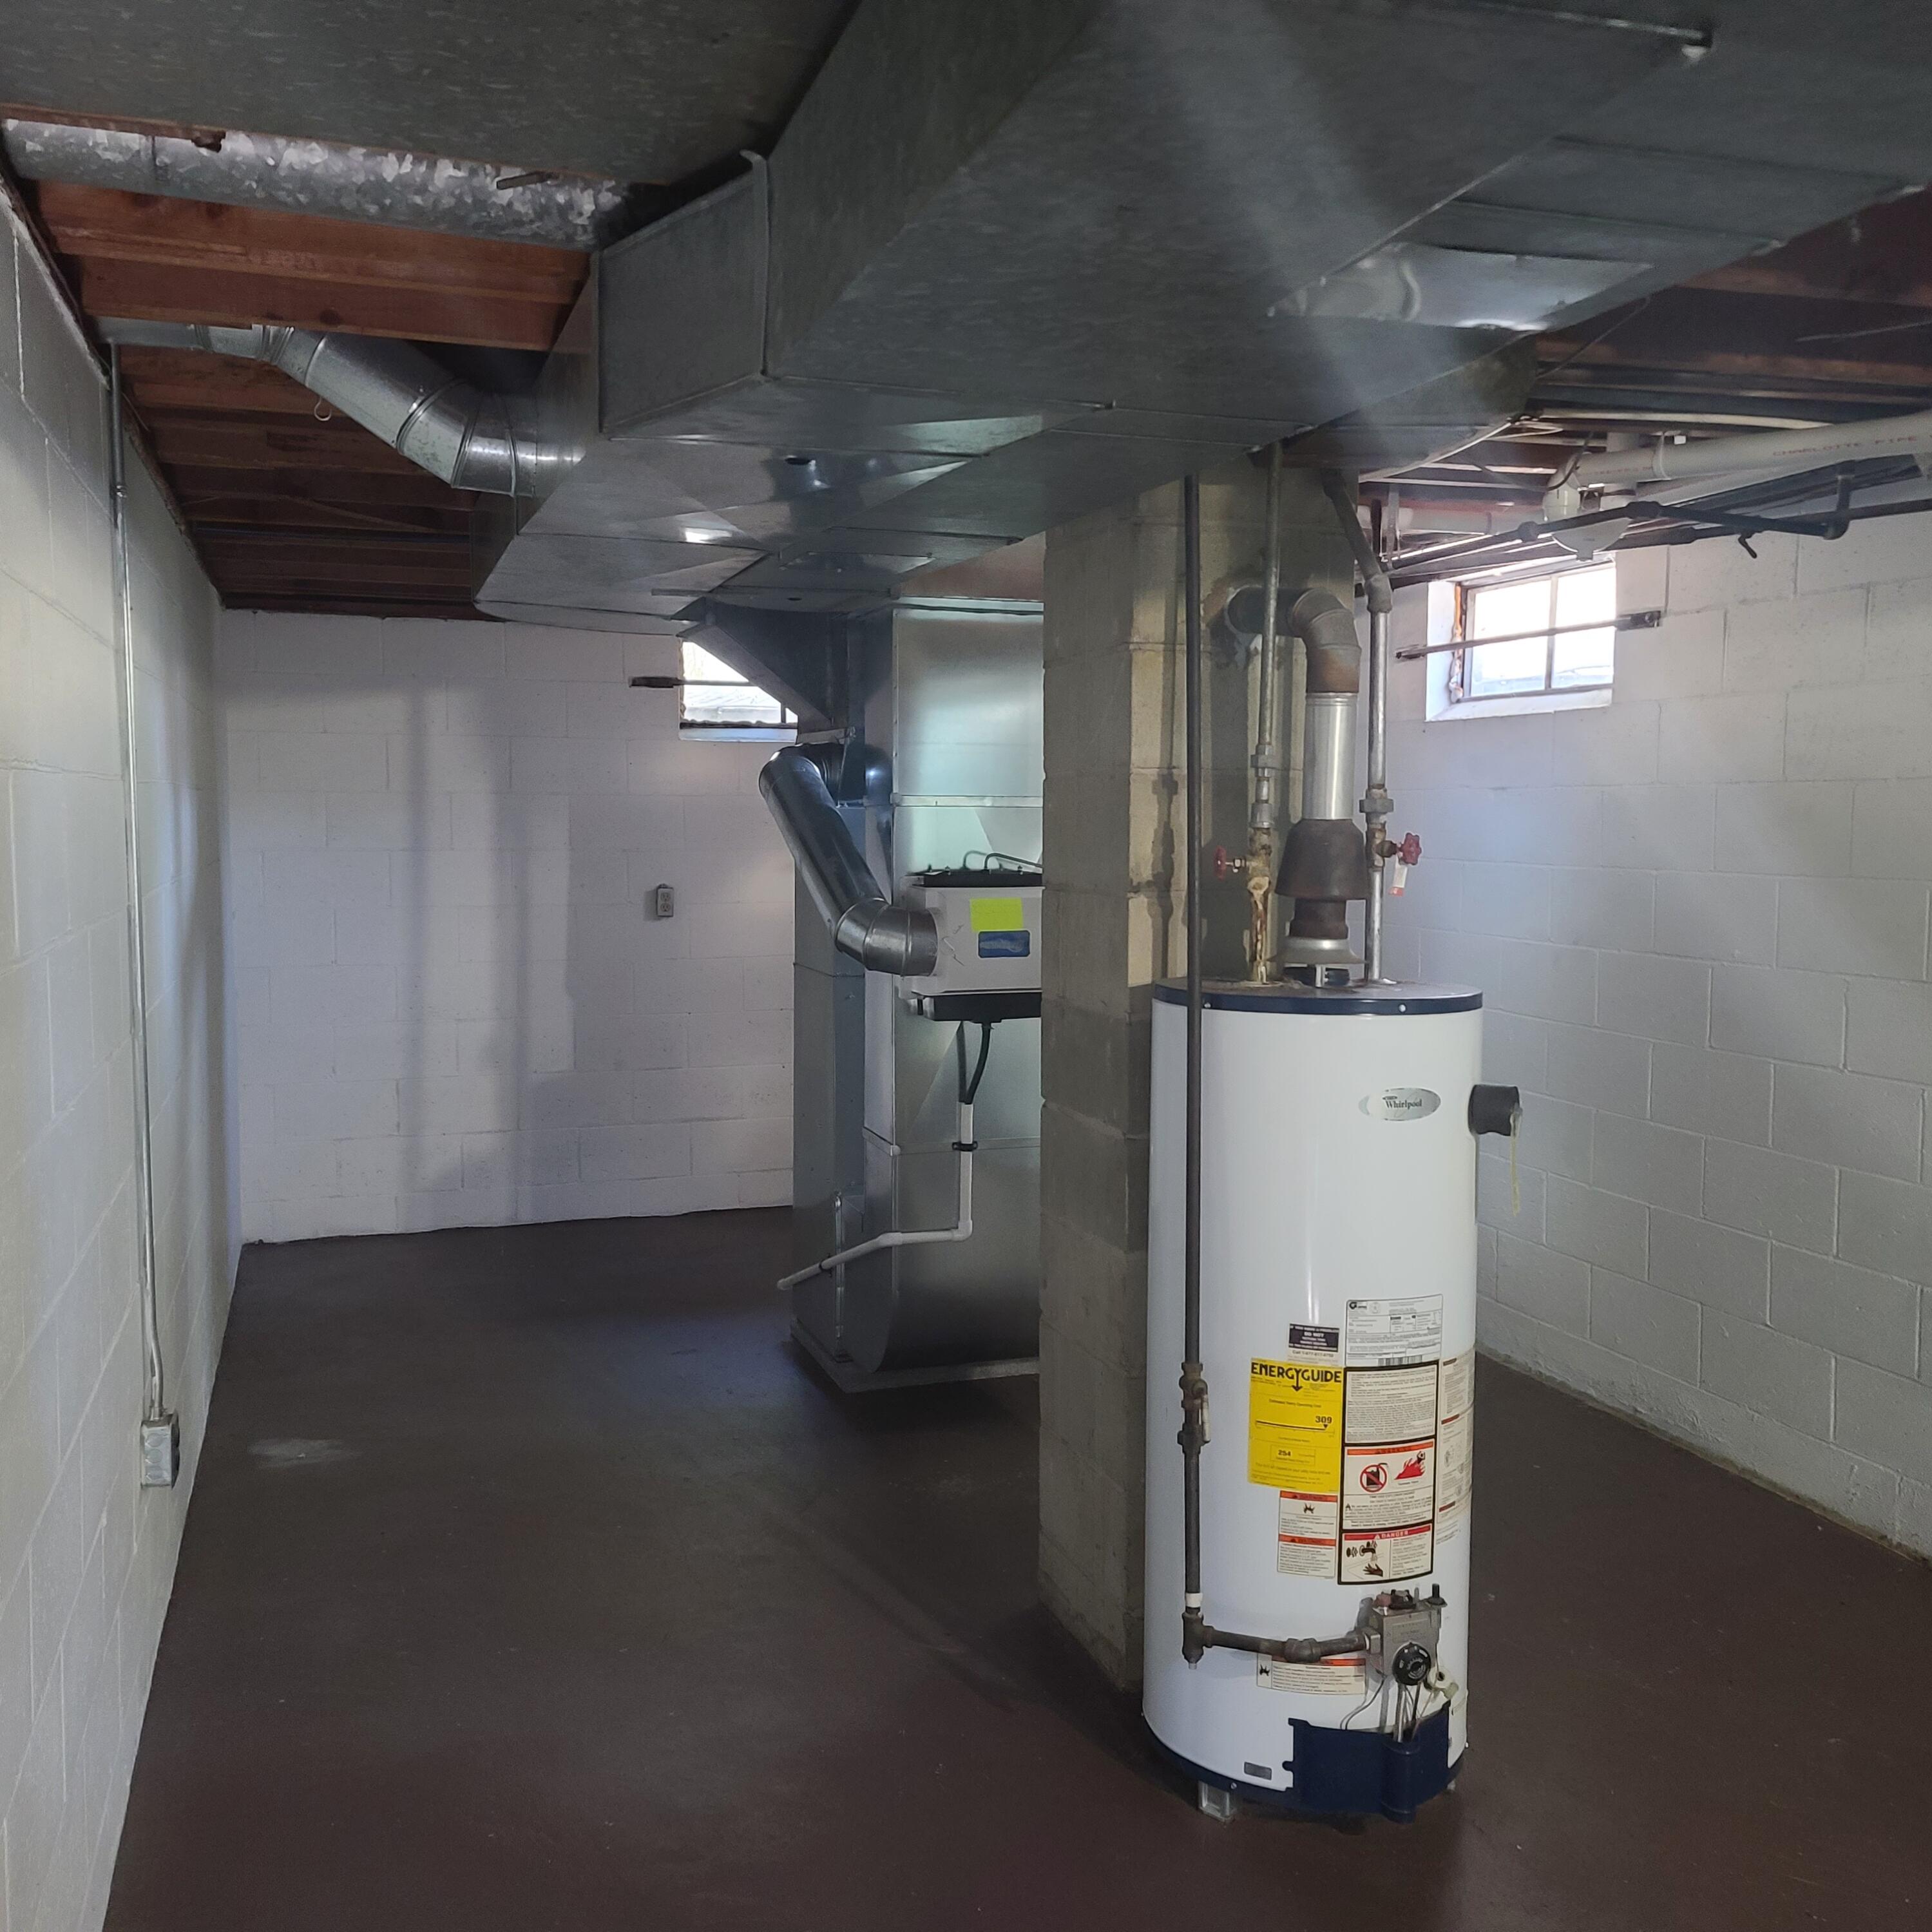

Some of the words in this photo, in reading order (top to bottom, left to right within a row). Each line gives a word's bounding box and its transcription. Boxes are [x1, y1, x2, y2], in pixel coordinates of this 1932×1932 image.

[1875, 435, 1917, 445] PIPE
[1385, 1098, 1422, 1109] Whirlpool
[1315, 1415, 1332, 1424] 309
